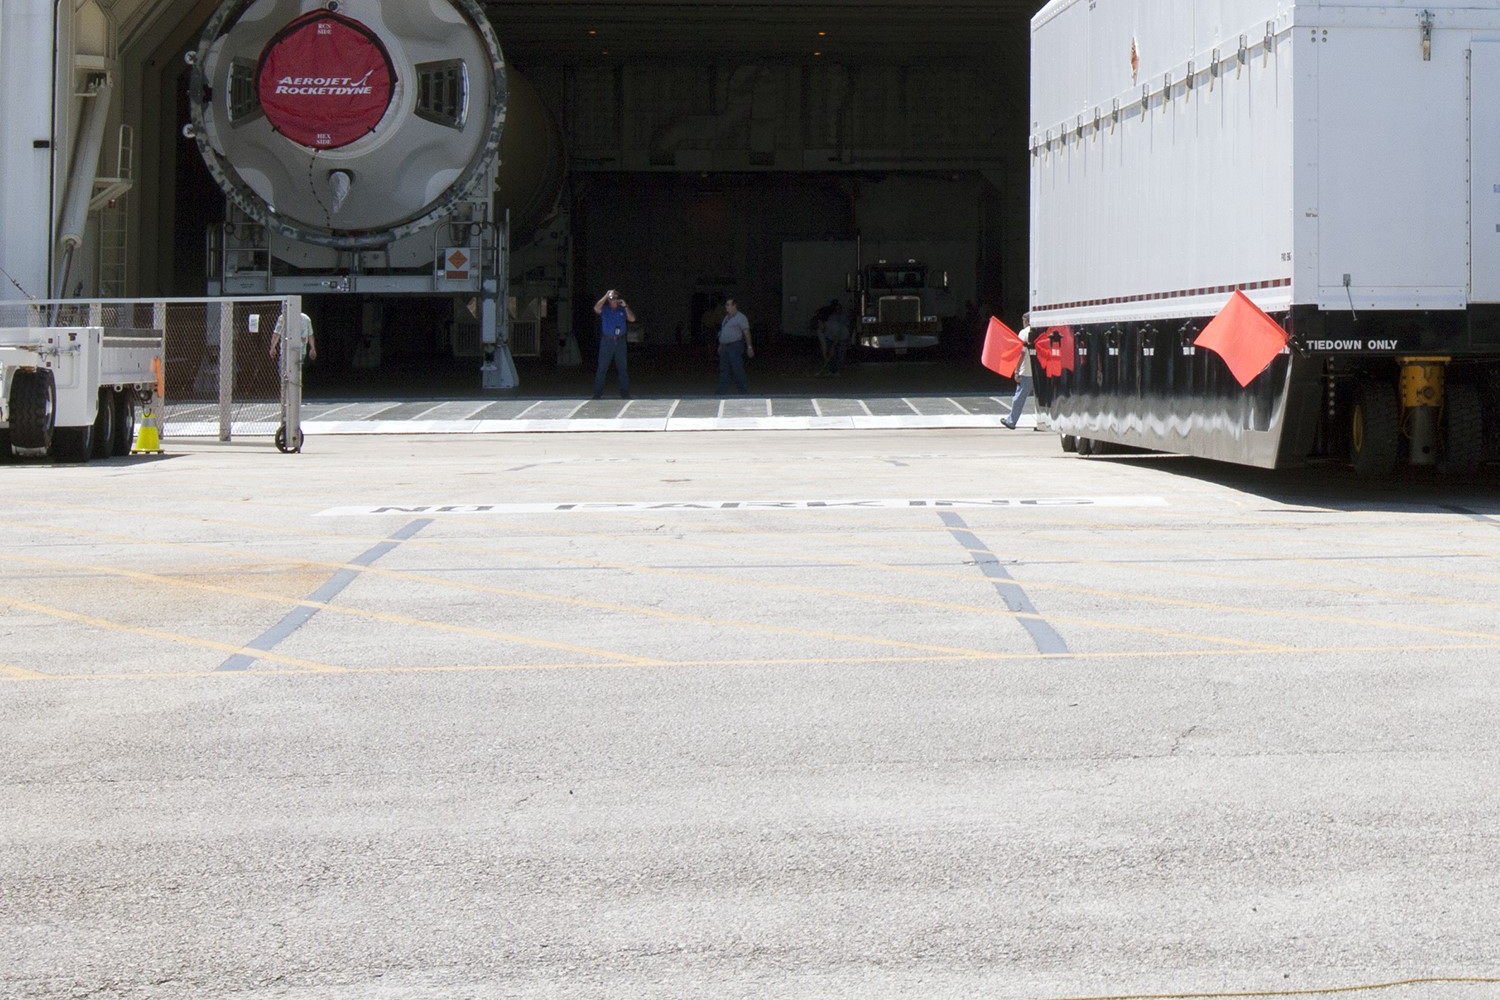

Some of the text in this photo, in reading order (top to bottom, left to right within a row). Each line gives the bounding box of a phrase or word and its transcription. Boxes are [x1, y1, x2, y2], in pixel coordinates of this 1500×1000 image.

[278, 76, 352, 86] AEROJET
[275, 85, 373, 95] ROCKETDYNE
[1306, 340, 1398, 350] TIEDOWN ONLY
[554, 498, 1095, 511] PARKING
